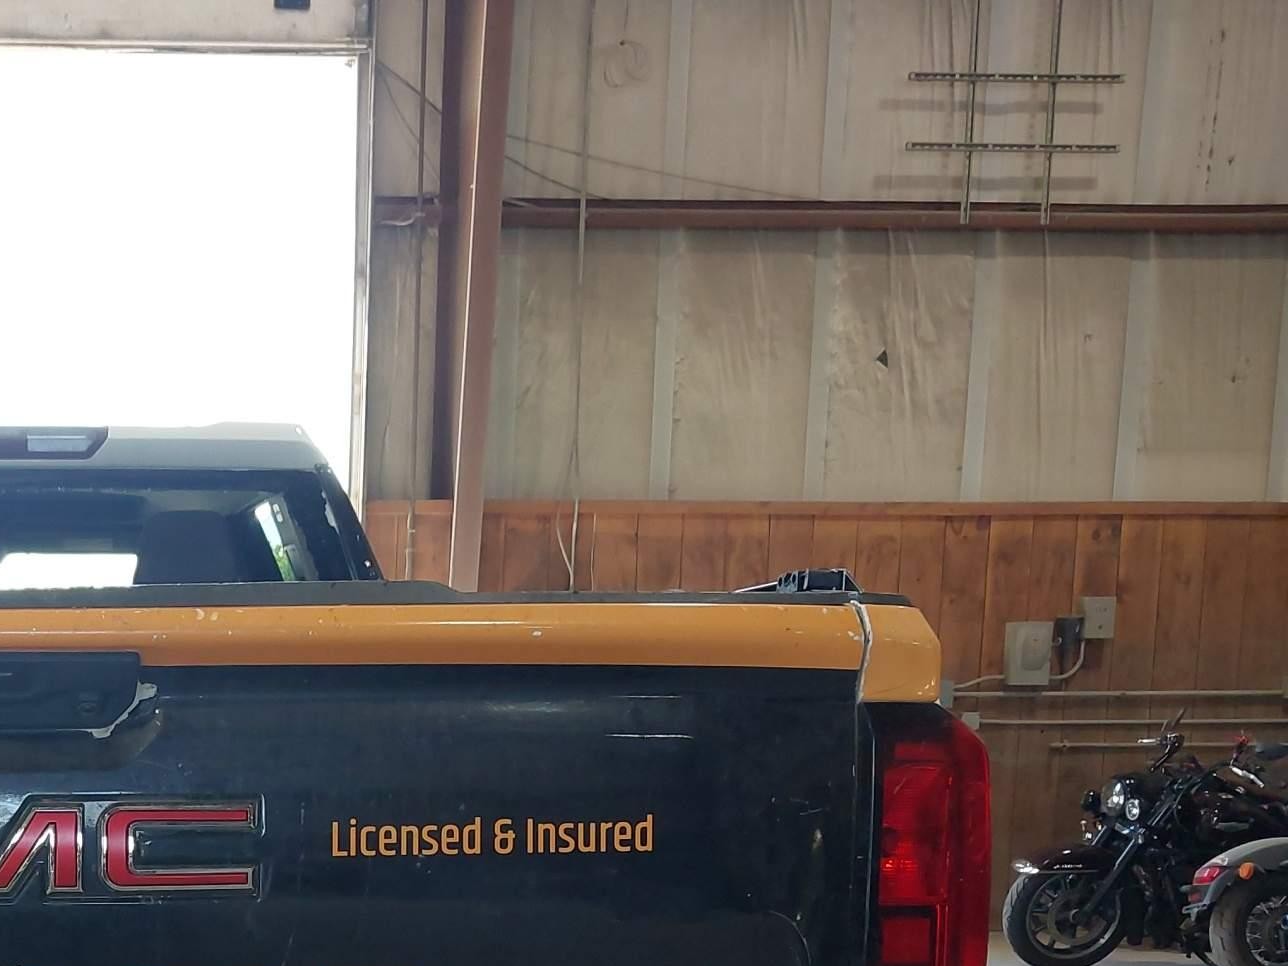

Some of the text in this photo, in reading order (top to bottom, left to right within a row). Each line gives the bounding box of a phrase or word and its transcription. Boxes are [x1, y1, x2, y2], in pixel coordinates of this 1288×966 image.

[331, 814, 654, 857] Licensed & Insured
